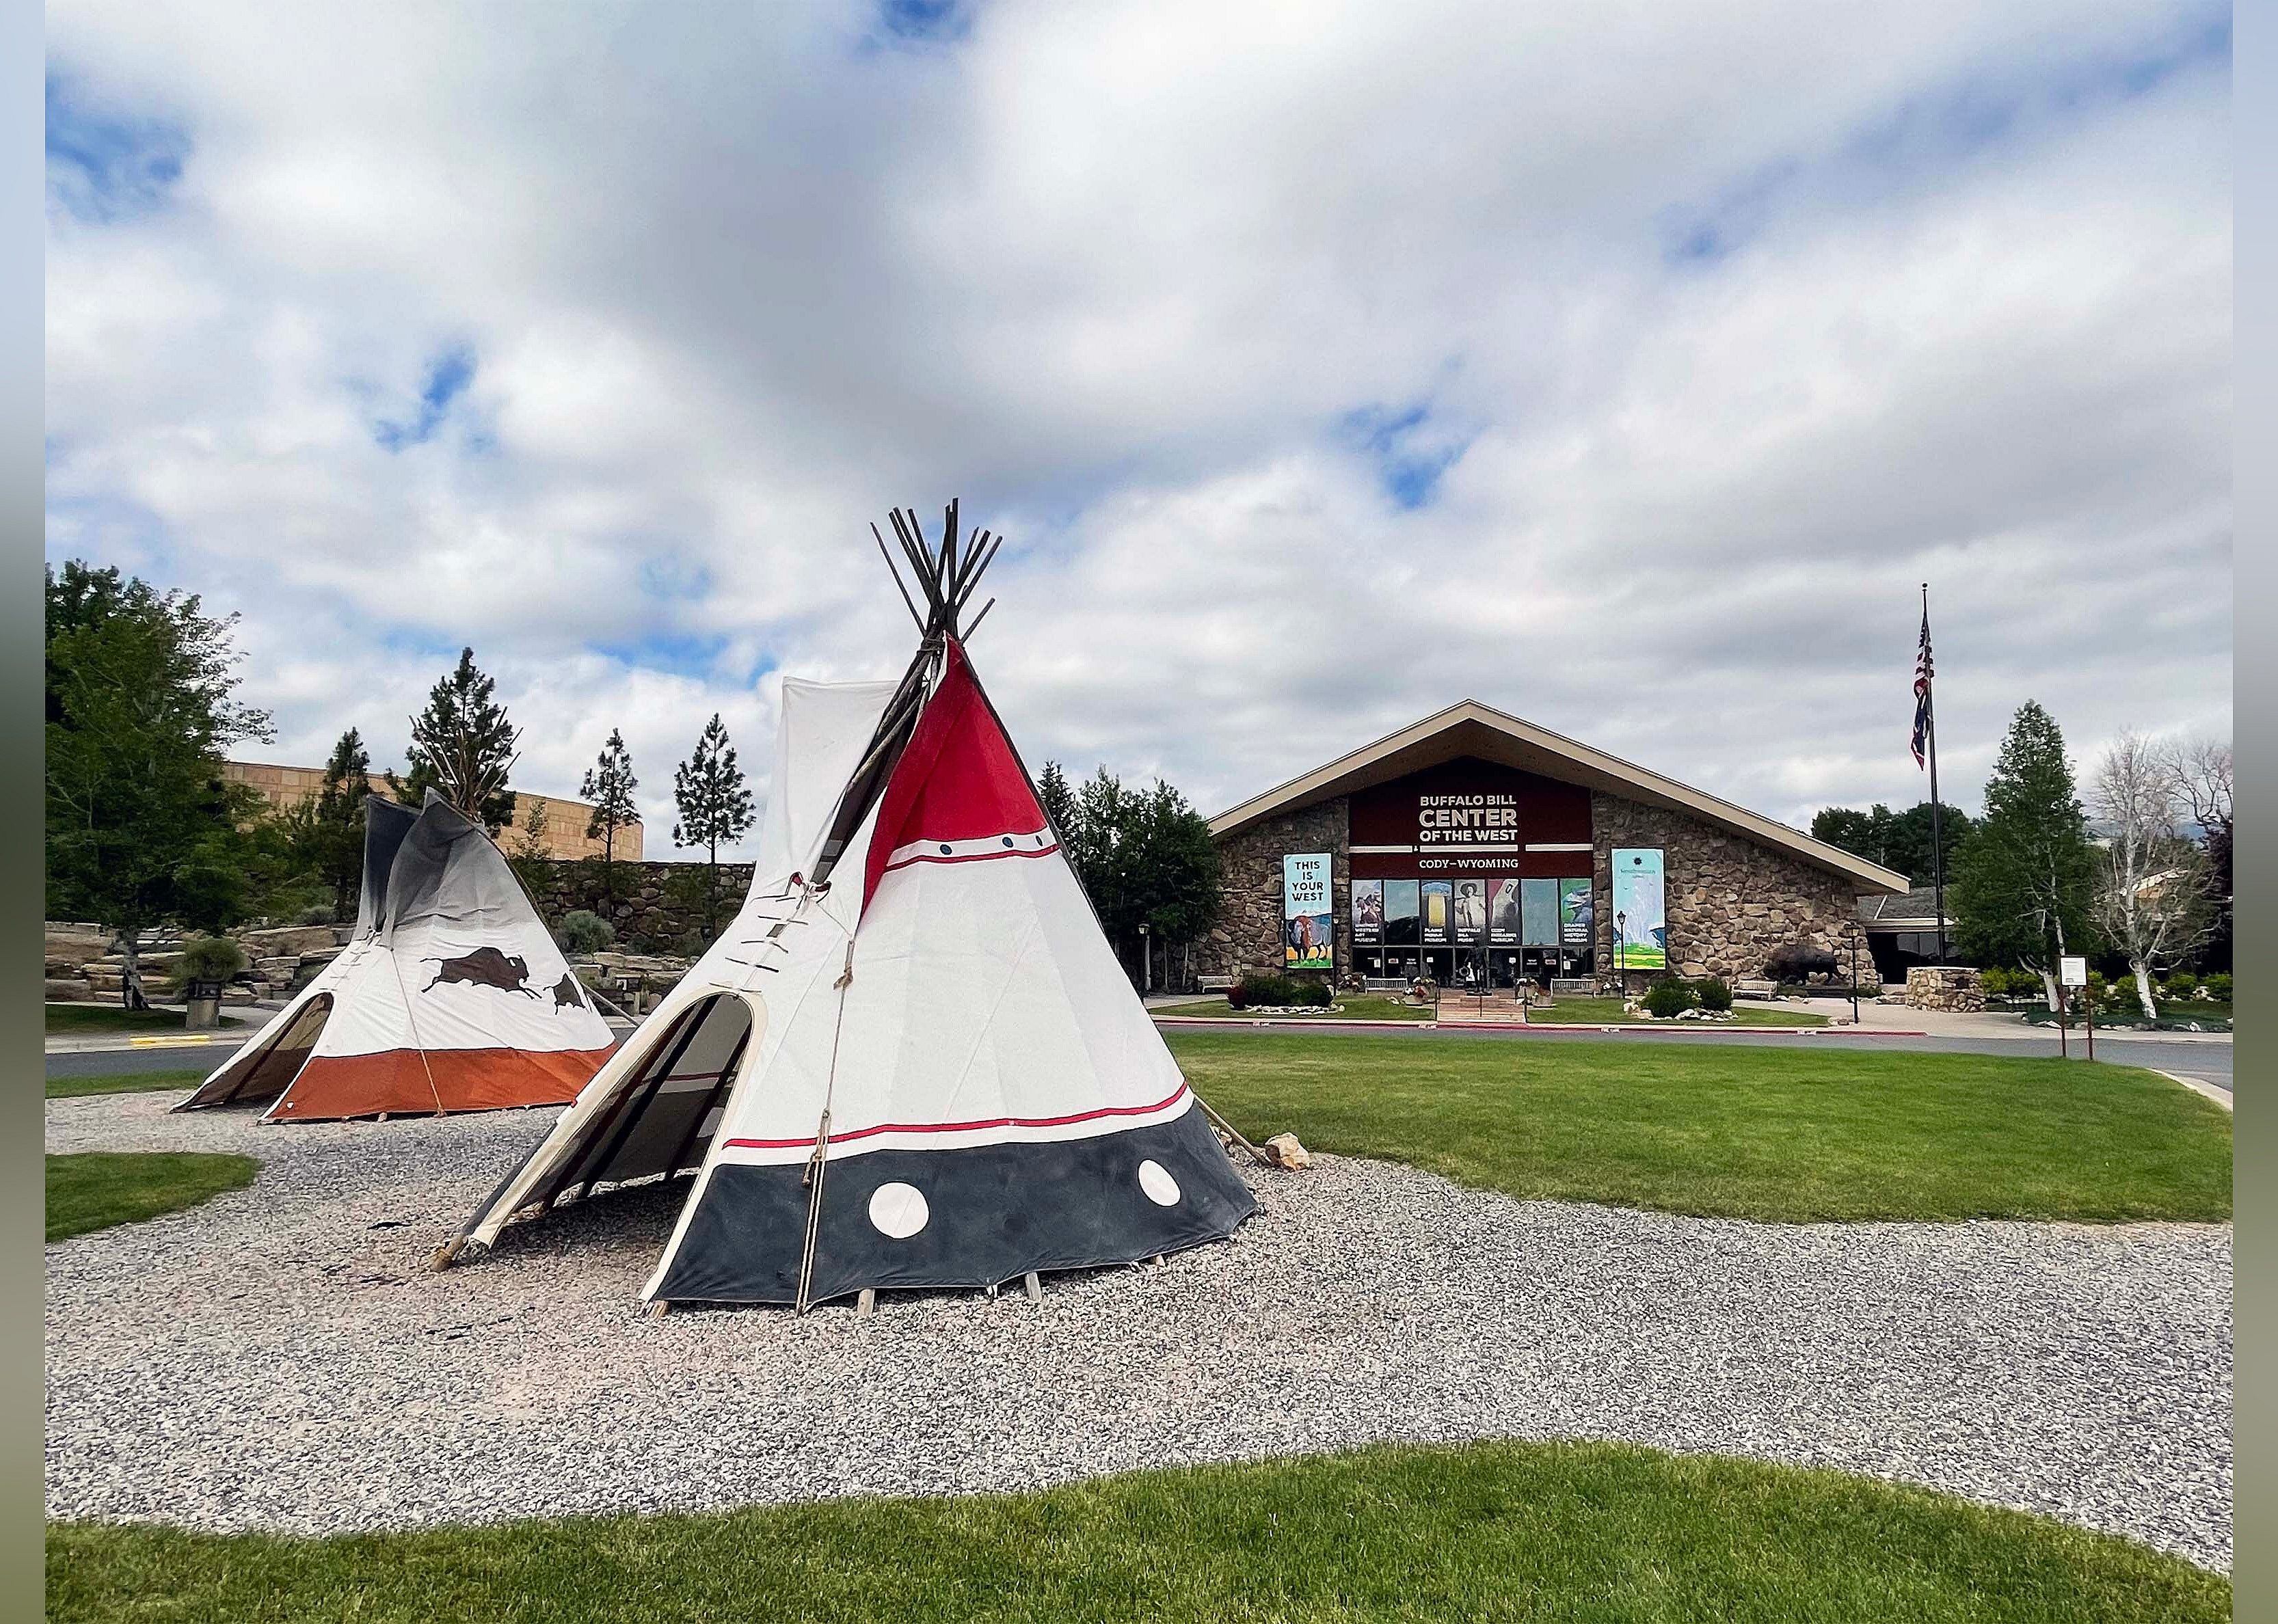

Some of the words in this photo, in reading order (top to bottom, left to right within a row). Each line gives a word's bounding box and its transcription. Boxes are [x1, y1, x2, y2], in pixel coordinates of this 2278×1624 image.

[1420, 795, 1484, 807] BUFFALO
[1486, 795, 1517, 805] BILL
[1419, 809, 1518, 828] CENTER
[1419, 830, 1440, 842] OF
[1443, 830, 1473, 841] THE
[1475, 829, 1518, 841] WEST
[1294, 861, 1320, 870] THIS
[1302, 871, 1313, 880] IS
[1291, 882, 1324, 891] YOUR
[1291, 892, 1324, 902] WEST
